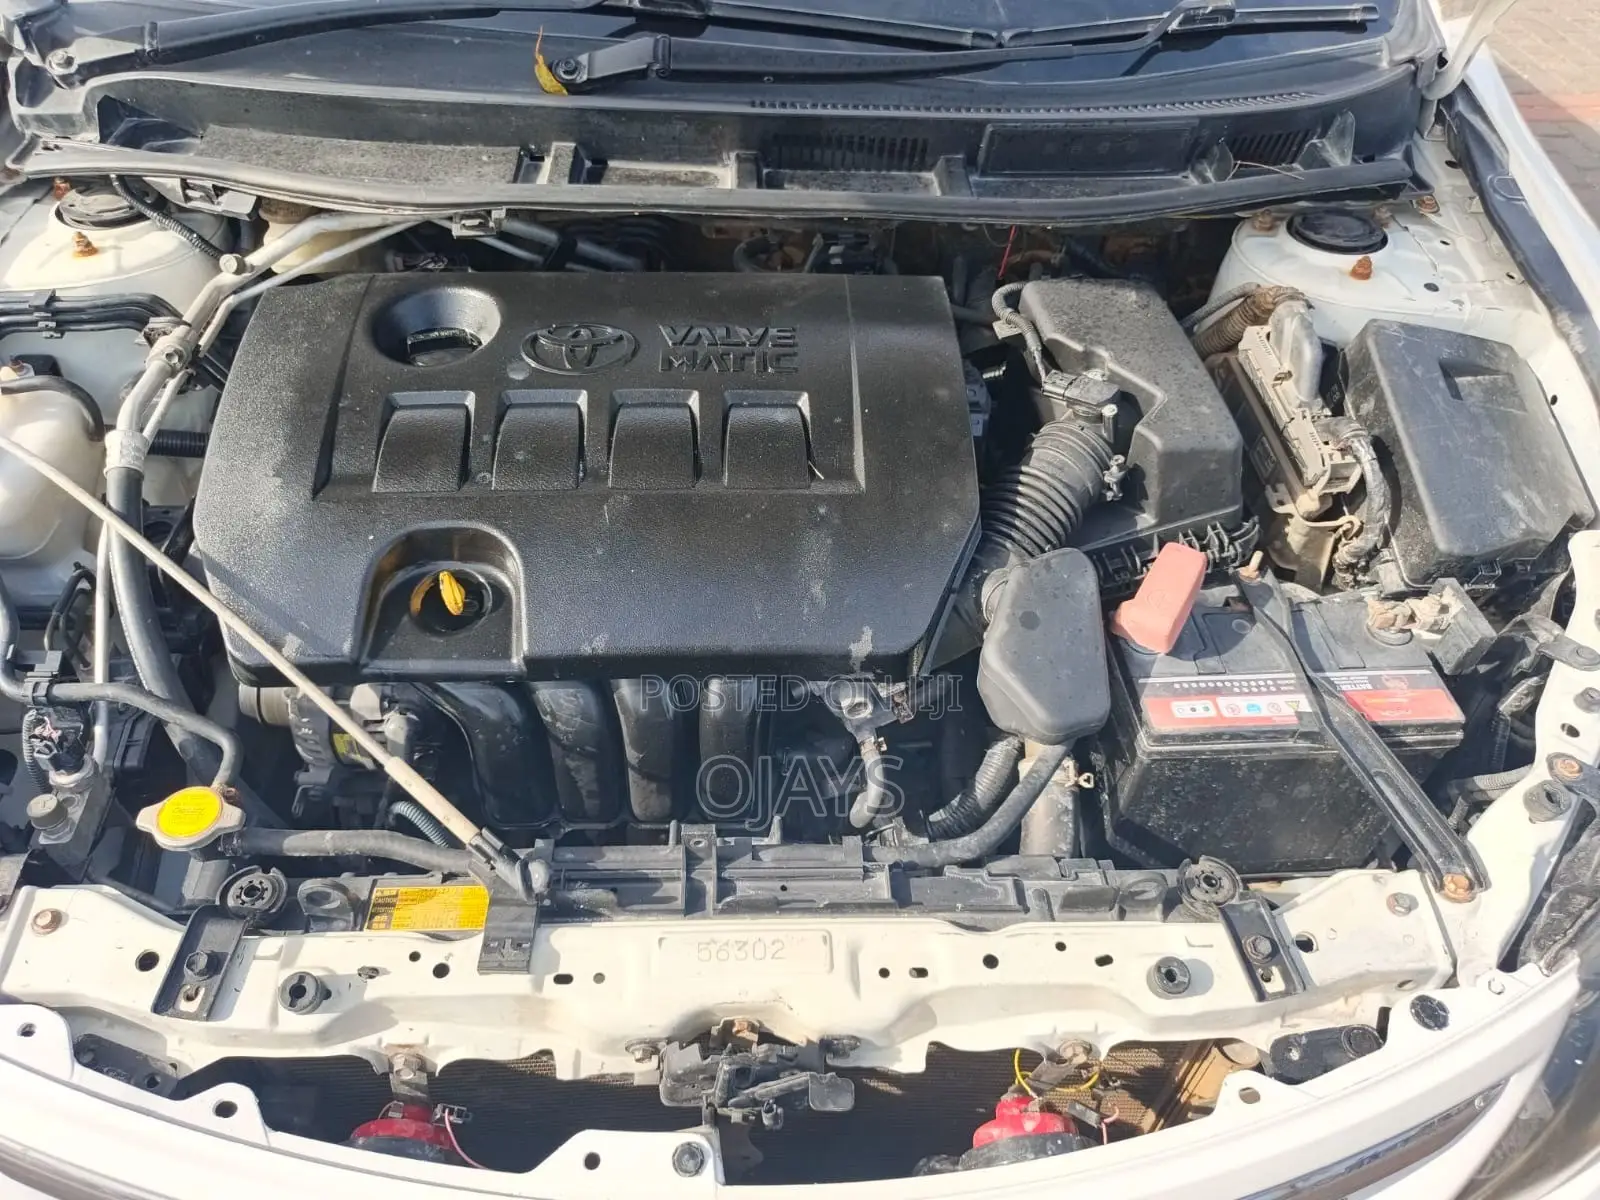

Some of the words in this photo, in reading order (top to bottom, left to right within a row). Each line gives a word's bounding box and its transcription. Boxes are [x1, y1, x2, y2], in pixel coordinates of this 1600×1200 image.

[657, 325, 797, 348] VALVE
[659, 350, 798, 374] MATIC
[697, 938, 786, 962] 56302
